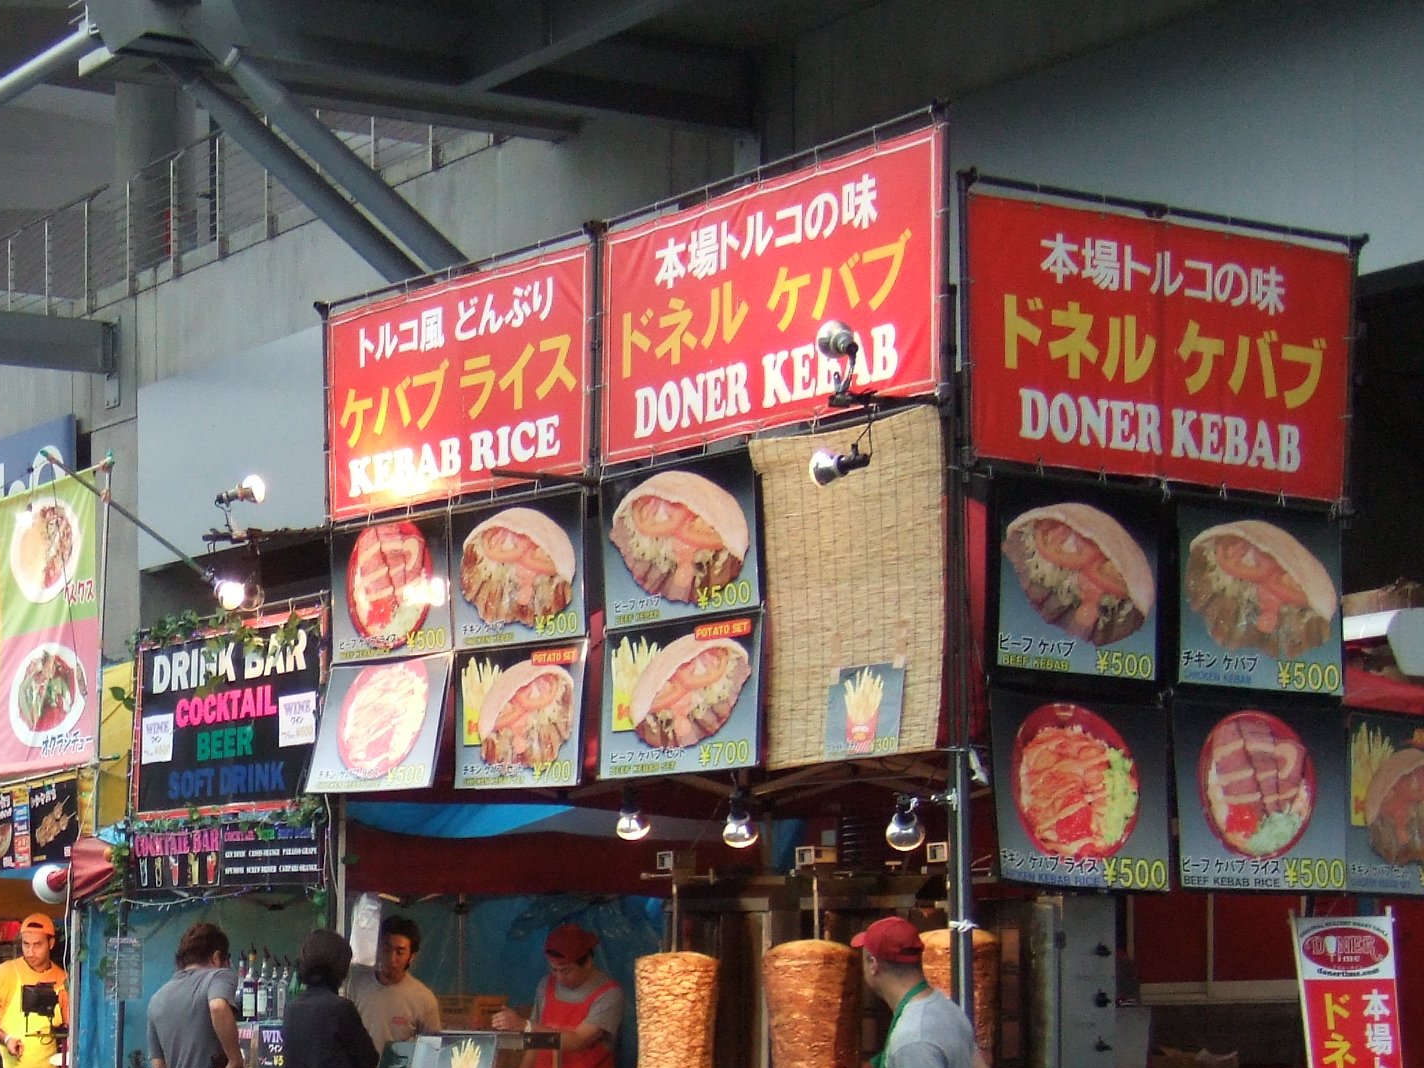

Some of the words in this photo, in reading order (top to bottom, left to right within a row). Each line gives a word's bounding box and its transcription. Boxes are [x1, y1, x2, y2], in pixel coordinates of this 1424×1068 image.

[654, 175, 877, 290] 本場トルコの味
[1040, 234, 1285, 316] 本場トルコの味
[621, 281, 749, 379] ドネル
[766, 229, 912, 332] ケバブ
[359, 305, 444, 368] トルコ風
[455, 276, 555, 342] どんぶり
[1003, 294, 1157, 384] ドネル
[1177, 320, 1327, 409] ケバブ
[340, 360, 450, 449] ケバブ
[459, 333, 577, 420] ライス
[634, 356, 751, 439] DONER
[762, 323, 899, 406] KEBAB
[1019, 389, 1162, 456] DONER
[1171, 409, 1301, 473] KEBAB
[348, 435, 462, 498] KEBAB
[470, 415, 561, 470] RICE
[697, 582, 751, 610] ¥500
[534, 612, 577, 636] ¥500
[729, 621, 750, 634] SET
[406, 630, 446, 651] ¥500
[999, 632, 1033, 653] ビーフ
[1038, 638, 1076, 657] ケバブ
[1032, 658, 1069, 672] KEBAB
[1095, 649, 1153, 679] ¥500
[1182, 649, 1217, 668] チキン
[1222, 652, 1258, 672] ケバブ
[1278, 661, 1340, 692] ¥500
[176, 684, 278, 729] COCKTAIL
[196, 725, 255, 762] BEER
[699, 740, 749, 767] ¥700
[168, 766, 217, 800] SOFT
[219, 761, 285, 797] DRINK
[386, 764, 425, 786] ¥500
[532, 760, 571, 784] ¥700
[1028, 854, 1059, 872] ケバブ
[1065, 856, 1099, 874] ライス
[1103, 857, 1168, 890] ¥500
[1182, 858, 1210, 873] ビーフ
[1214, 858, 1246, 874] ケバブ
[1251, 858, 1280, 874] ライス
[1284, 857, 1345, 889] ¥500
[1183, 876, 1210, 887] BEEF
[1213, 876, 1249, 888] KEBAB
[1252, 877, 1280, 888] RICE
[262, 1029, 284, 1043] WIN
